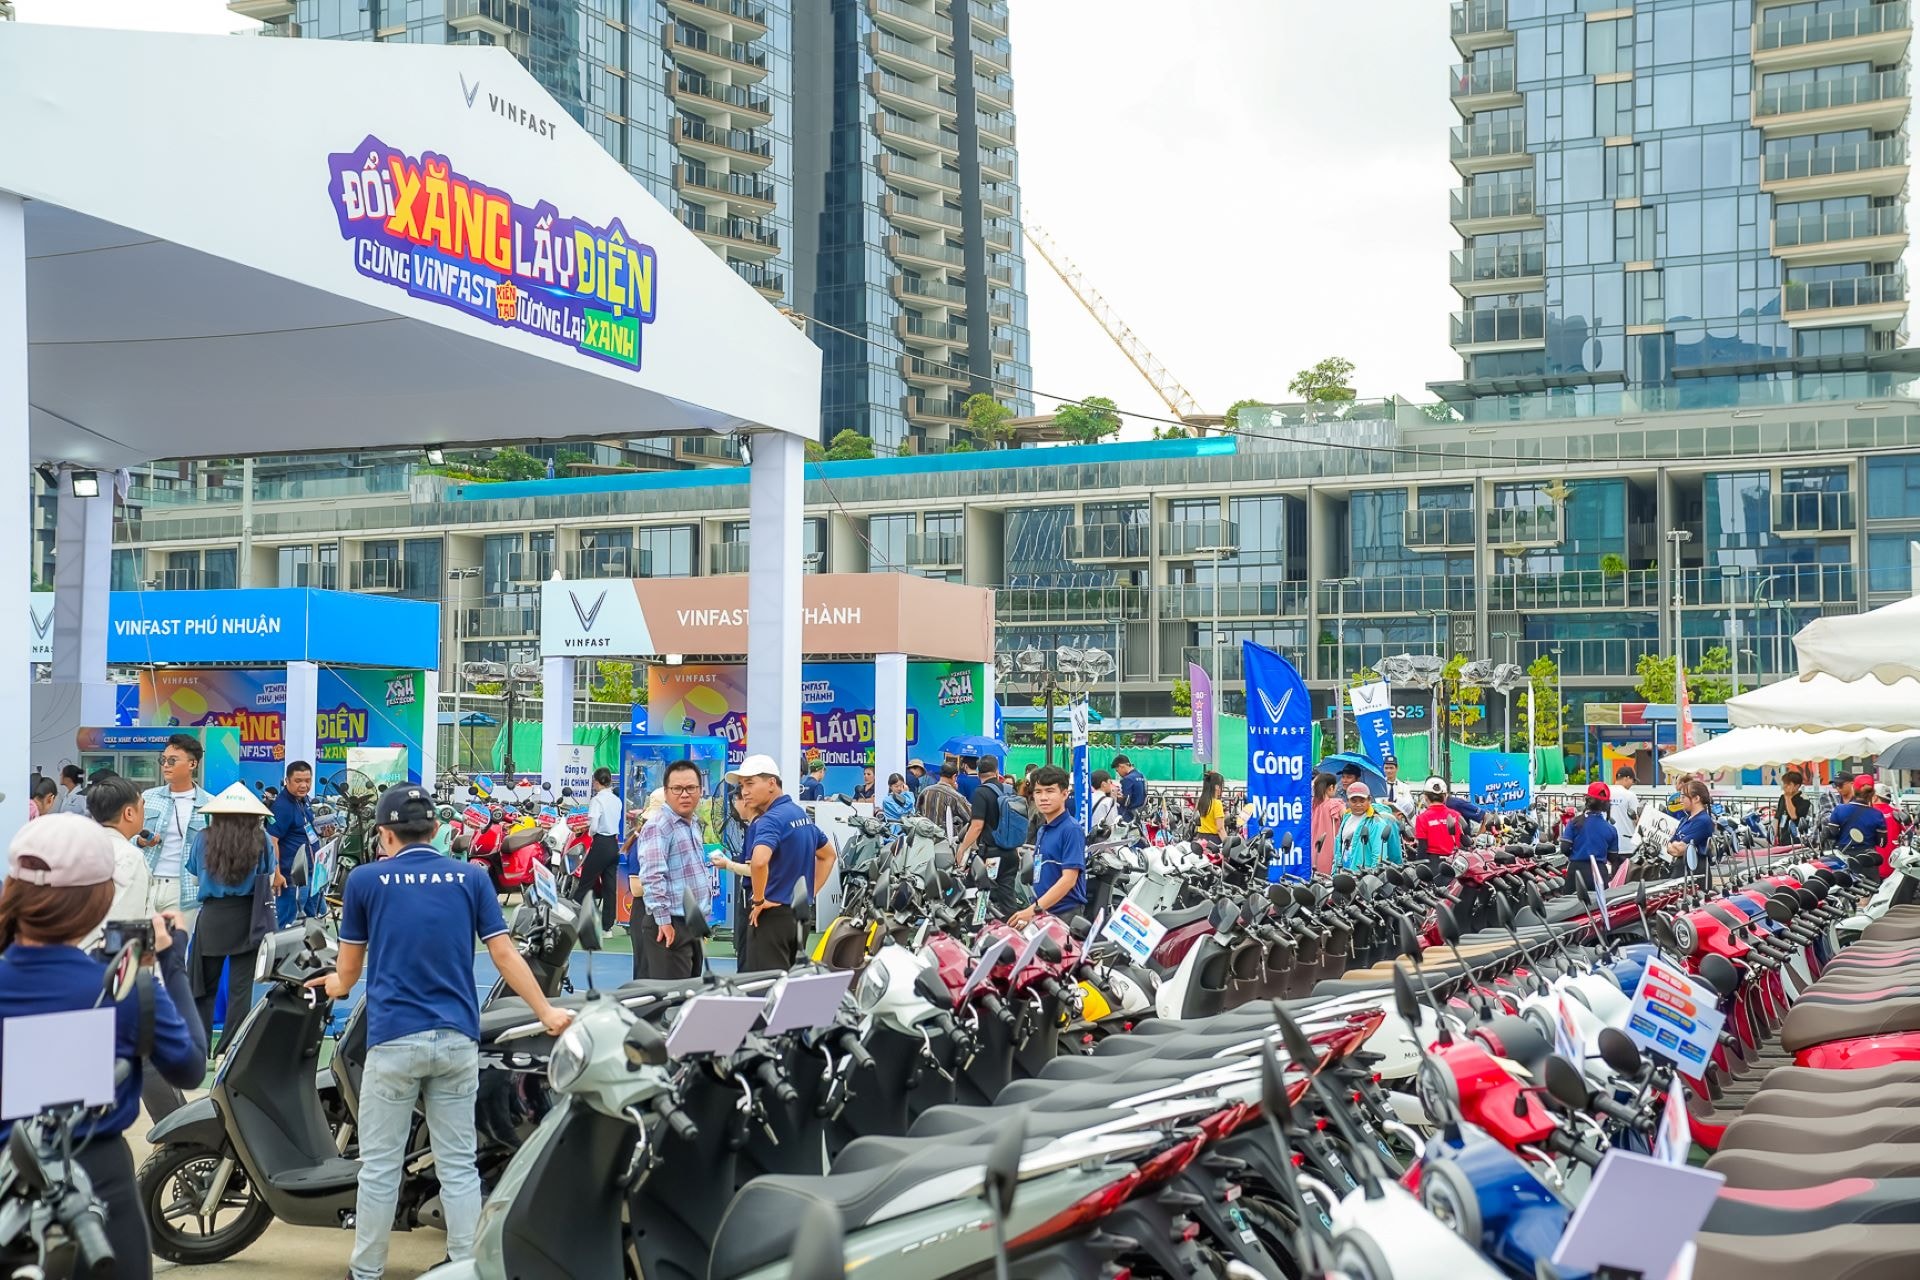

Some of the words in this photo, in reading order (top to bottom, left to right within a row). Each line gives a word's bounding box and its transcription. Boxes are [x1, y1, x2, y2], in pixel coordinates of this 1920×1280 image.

[489, 93, 556, 140] VINFAST
[385, 158, 512, 275] XĂNG
[359, 239, 411, 284] CÙNG
[516, 291, 561, 337] TƯƠNG
[585, 313, 635, 359] XANH
[677, 609, 748, 627] VINFAST
[802, 603, 861, 626] HÀNH
[114, 618, 181, 636] VINFAST
[184, 614, 218, 635] PHÚ
[222, 613, 281, 638] NHUẬN
[564, 637, 611, 647] VINFAST
[162, 676, 199, 685] VINFAST
[674, 673, 717, 683] VINFAST
[801, 682, 828, 691] INFAST
[1389, 705, 1425, 719] GS25
[1250, 725, 1306, 735] VINFAST
[1252, 750, 1304, 781] Công
[1252, 795, 1303, 827] Nghệ
[379, 872, 466, 885] VINFAST
